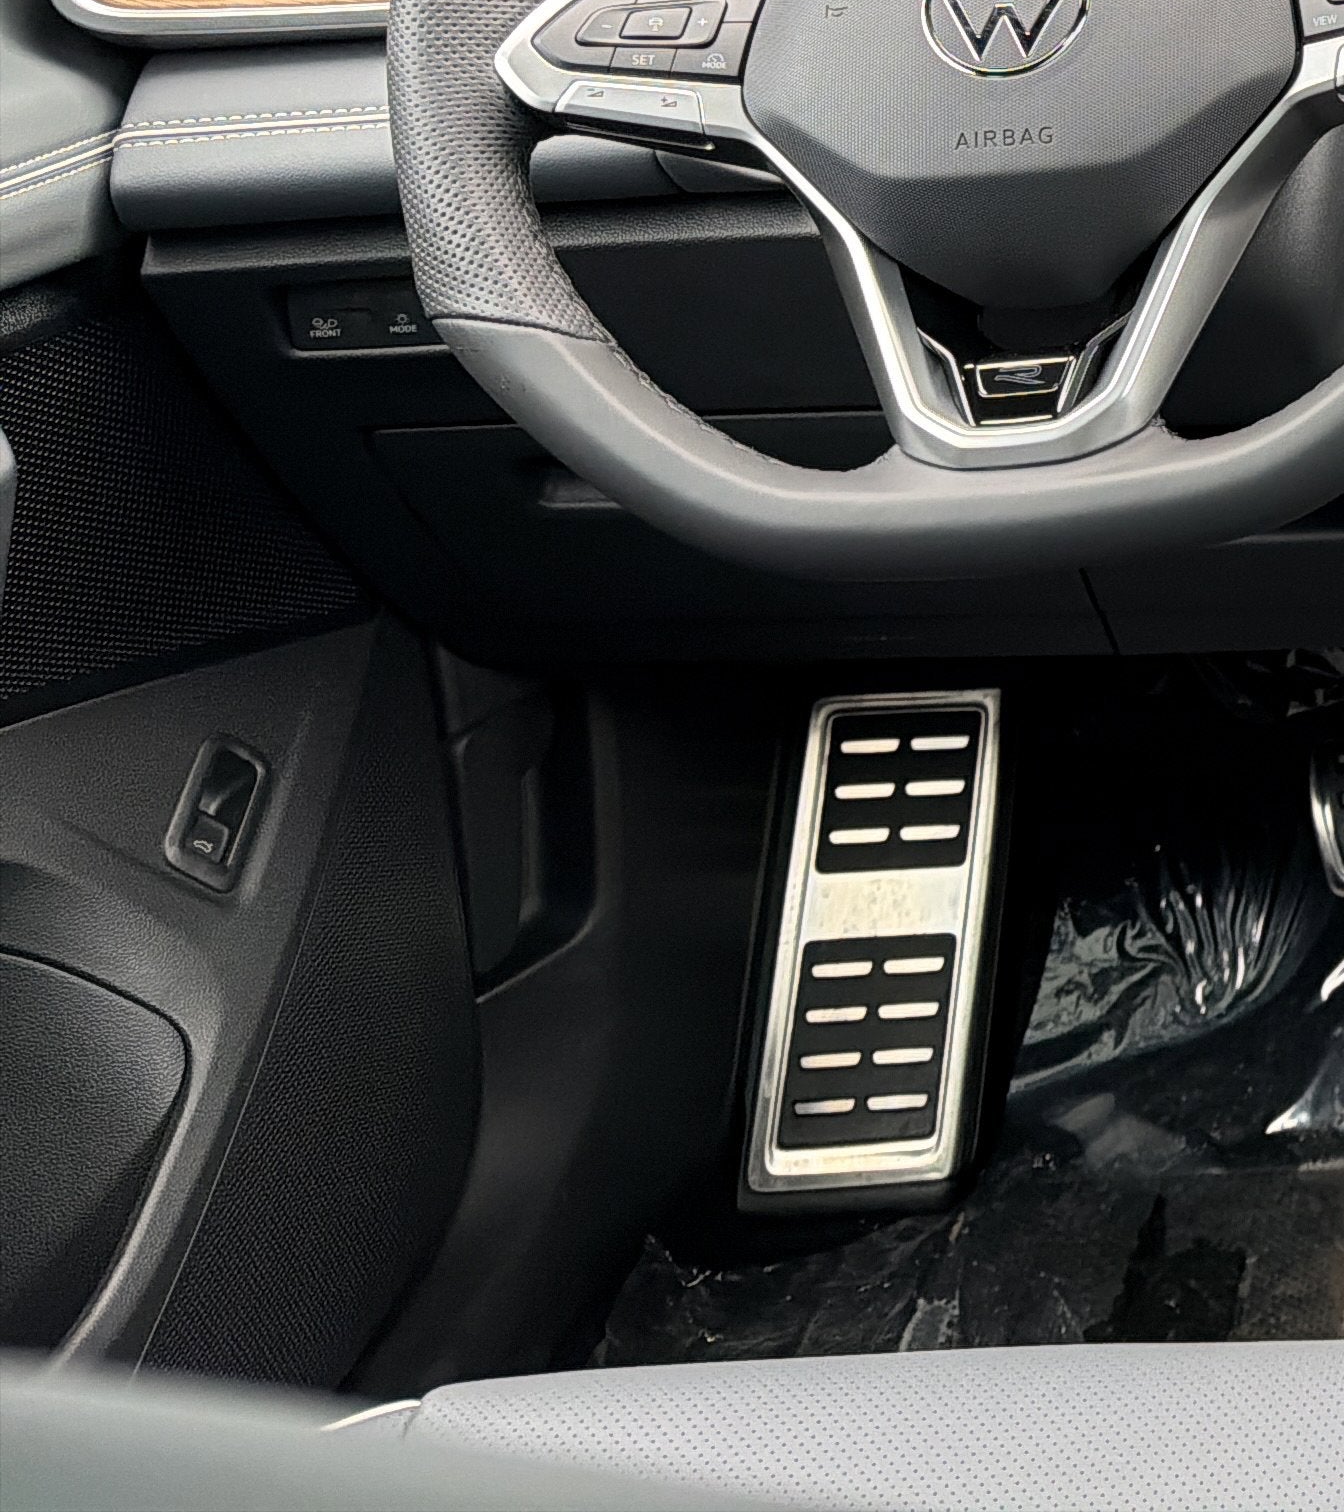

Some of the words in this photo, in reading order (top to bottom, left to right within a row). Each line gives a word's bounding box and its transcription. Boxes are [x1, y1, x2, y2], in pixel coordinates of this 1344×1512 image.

[1312, 14, 1337, 27] VIEW
[631, 54, 656, 66] SET
[702, 60, 728, 70] MODE
[953, 125, 1055, 150] AIRBAG
[309, 328, 342, 339] FRONT
[388, 324, 419, 334] MODE
